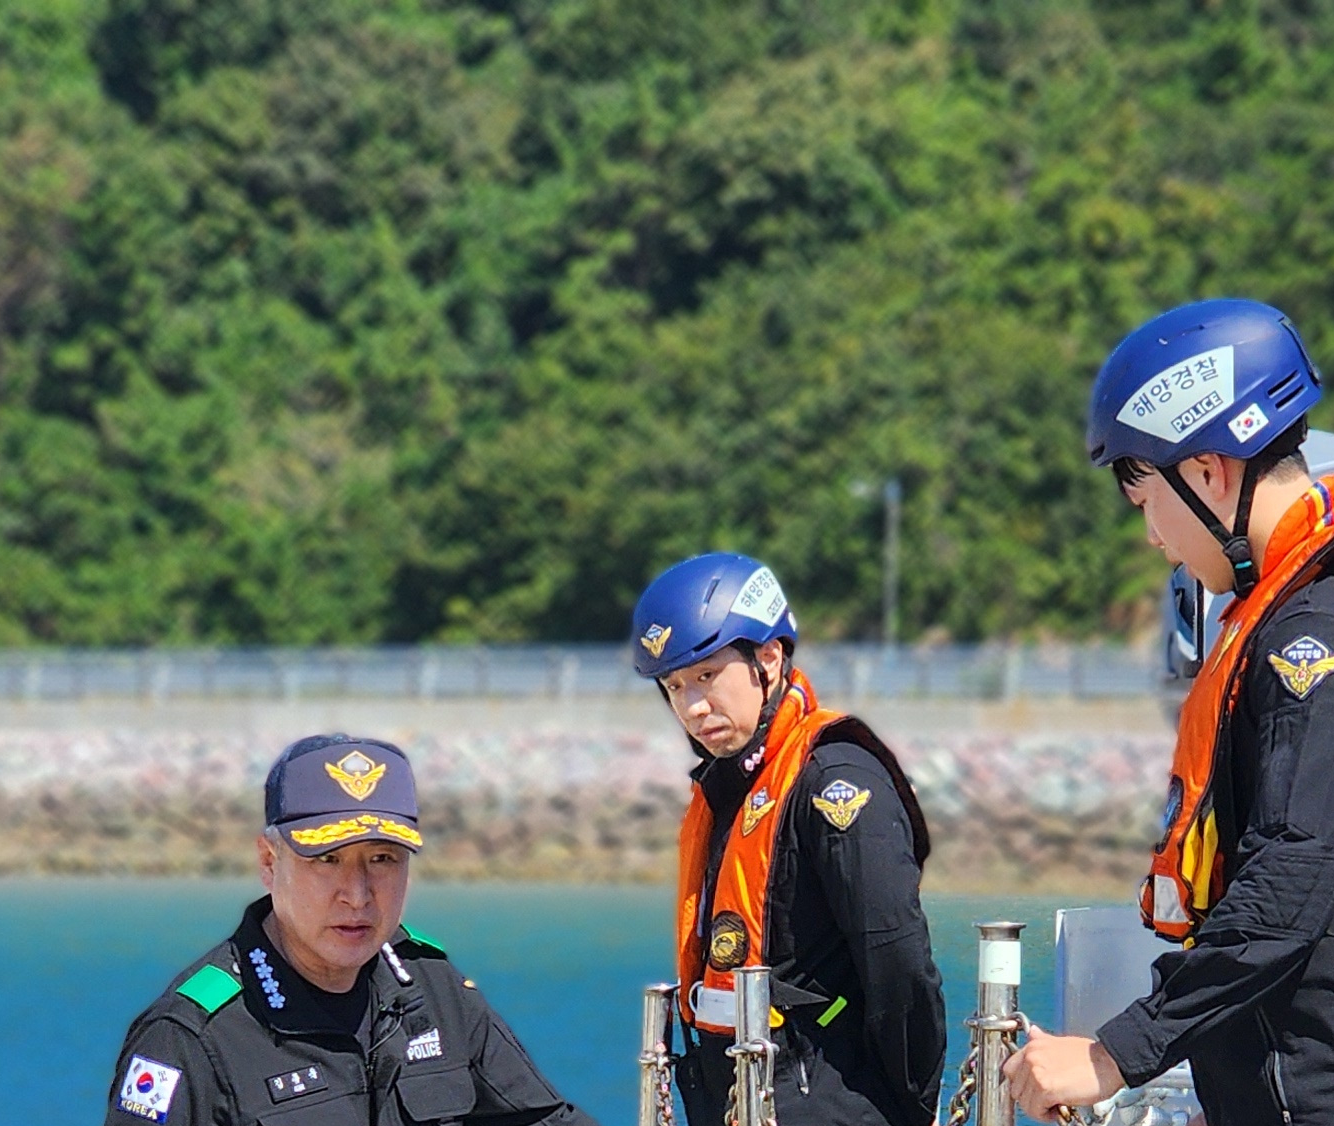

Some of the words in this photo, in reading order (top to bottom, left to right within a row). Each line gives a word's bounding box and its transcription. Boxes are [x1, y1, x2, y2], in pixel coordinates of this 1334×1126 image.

[1132, 356, 1219, 417] 해양경찰
[1172, 391, 1223, 433] POLICE
[407, 1042, 443, 1061] POLICE
[121, 1100, 158, 1120] KOREA
